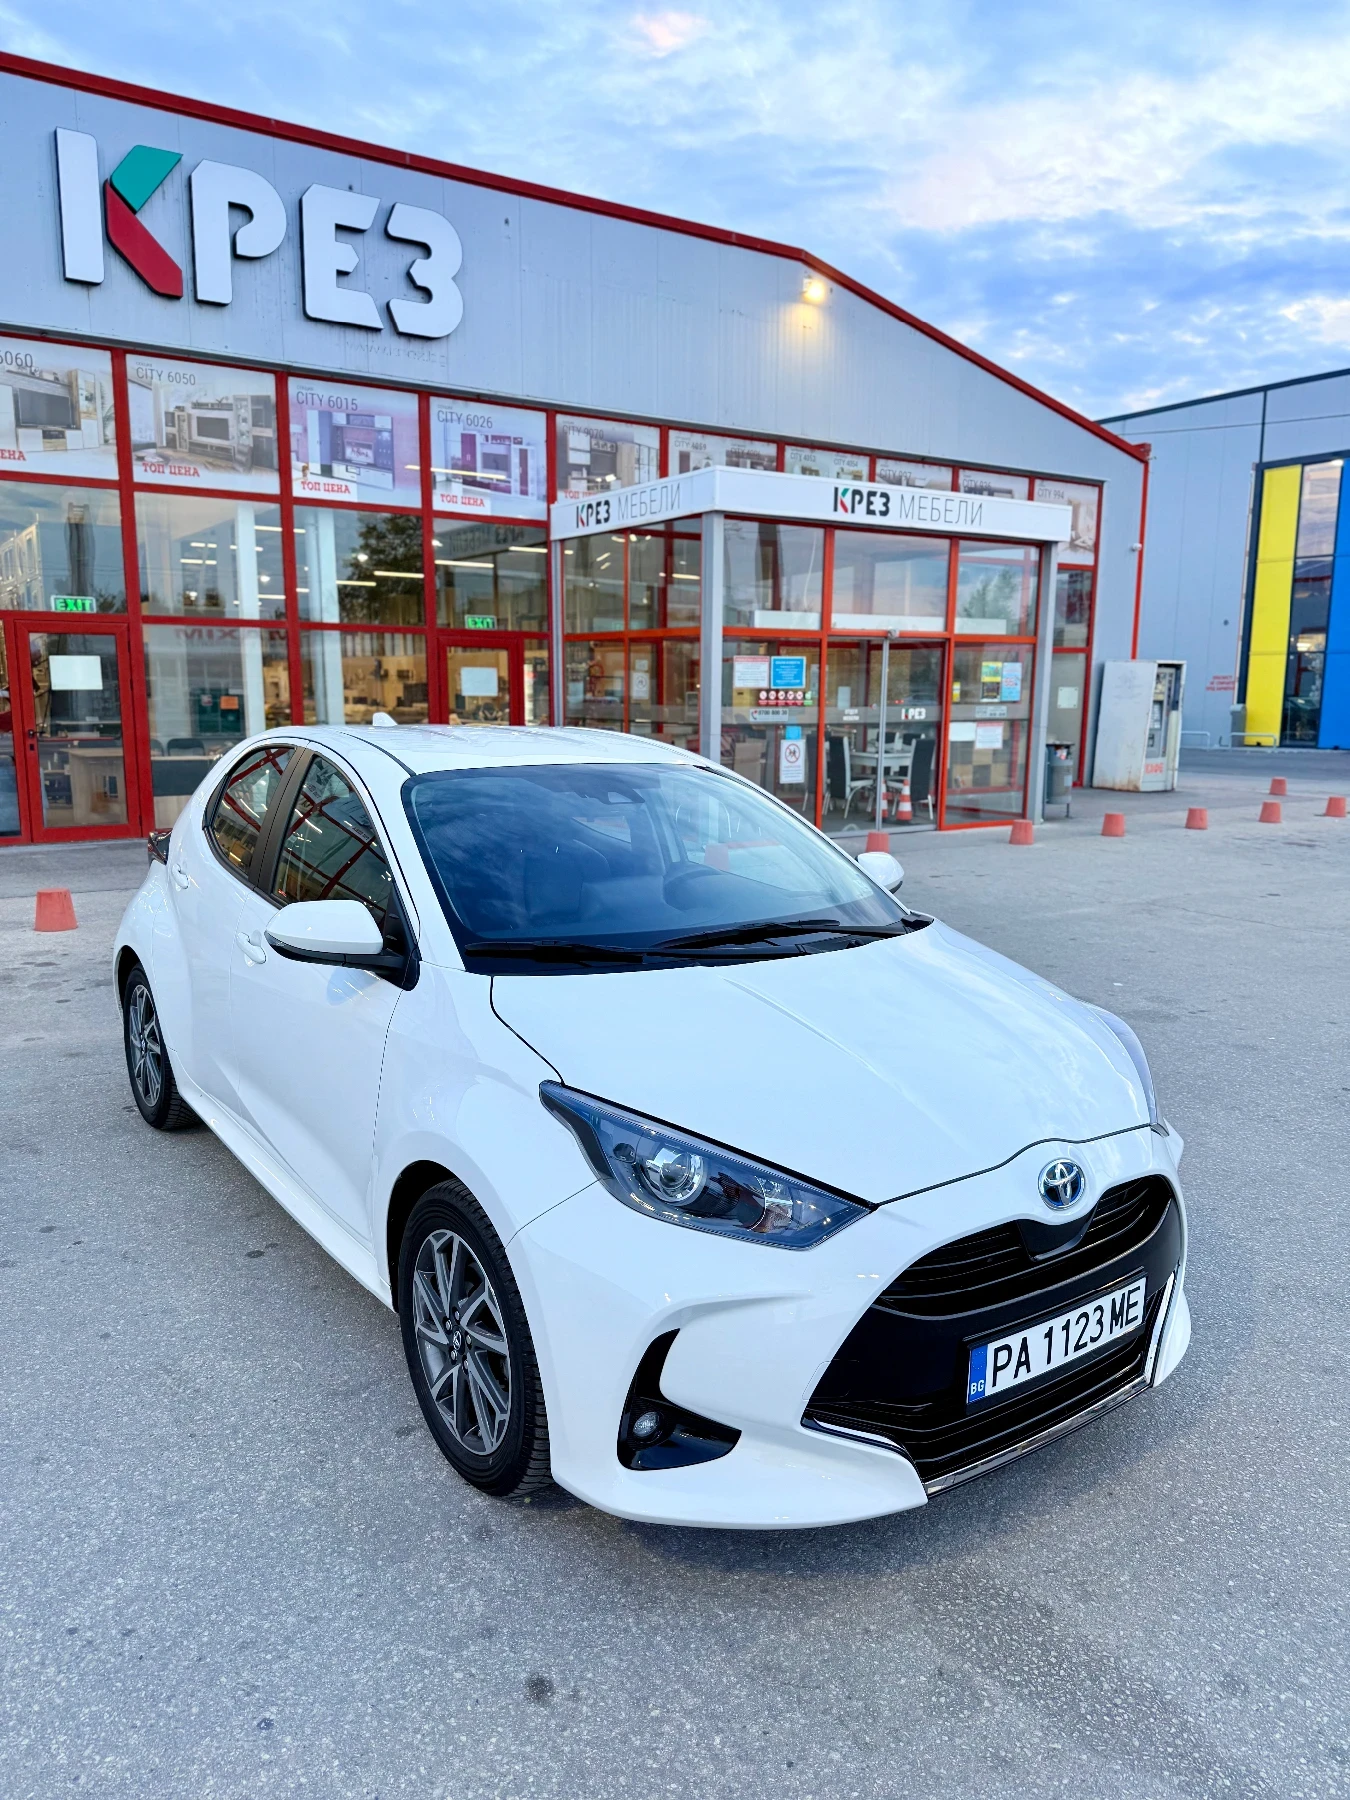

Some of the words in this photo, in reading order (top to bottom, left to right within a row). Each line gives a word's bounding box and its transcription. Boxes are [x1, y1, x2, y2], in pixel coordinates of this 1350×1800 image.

[55, 126, 463, 339] КРЕЗ
[136, 367, 163, 381] CITY
[167, 371, 196, 386] 6050
[296, 391, 324, 407] CITY
[328, 395, 358, 411] 6015
[437, 410, 463, 425] CITY
[466, 414, 493, 429] 6026
[562, 425, 582, 437] CITY
[585, 428, 604, 440] 9070
[674, 440, 690, 448] CITY
[790, 452, 802, 461] CITY
[833, 458, 846, 466] CITY
[142, 462, 165, 474] ТОП
[169, 464, 200, 477] ЦЕНА
[880, 469, 897, 479] CITY
[301, 481, 321, 492] ТОП
[323, 482, 351, 494] ЦЕНА
[963, 478, 978, 488] CITY
[563, 490, 580, 499] ТОП
[1037, 487, 1052, 498] CITY
[441, 494, 458, 504] ТОП
[461, 495, 485, 507] ЦЕНА
[576, 500, 611, 529] КРЕЗ
[618, 482, 681, 521] МЕБЕЛИ
[833, 486, 890, 517] КРЕЗ
[899, 494, 983, 526] МЕБЕЛИ
[56, 598, 92, 612] EXIT
[467, 617, 495, 629] EXIT
[901, 708, 926, 720] КРЕЗ
[970, 1379, 985, 1395] BG
[992, 1336, 1031, 1388] PA
[1043, 1304, 1105, 1365] 1123
[1109, 1285, 1141, 1335] ME
